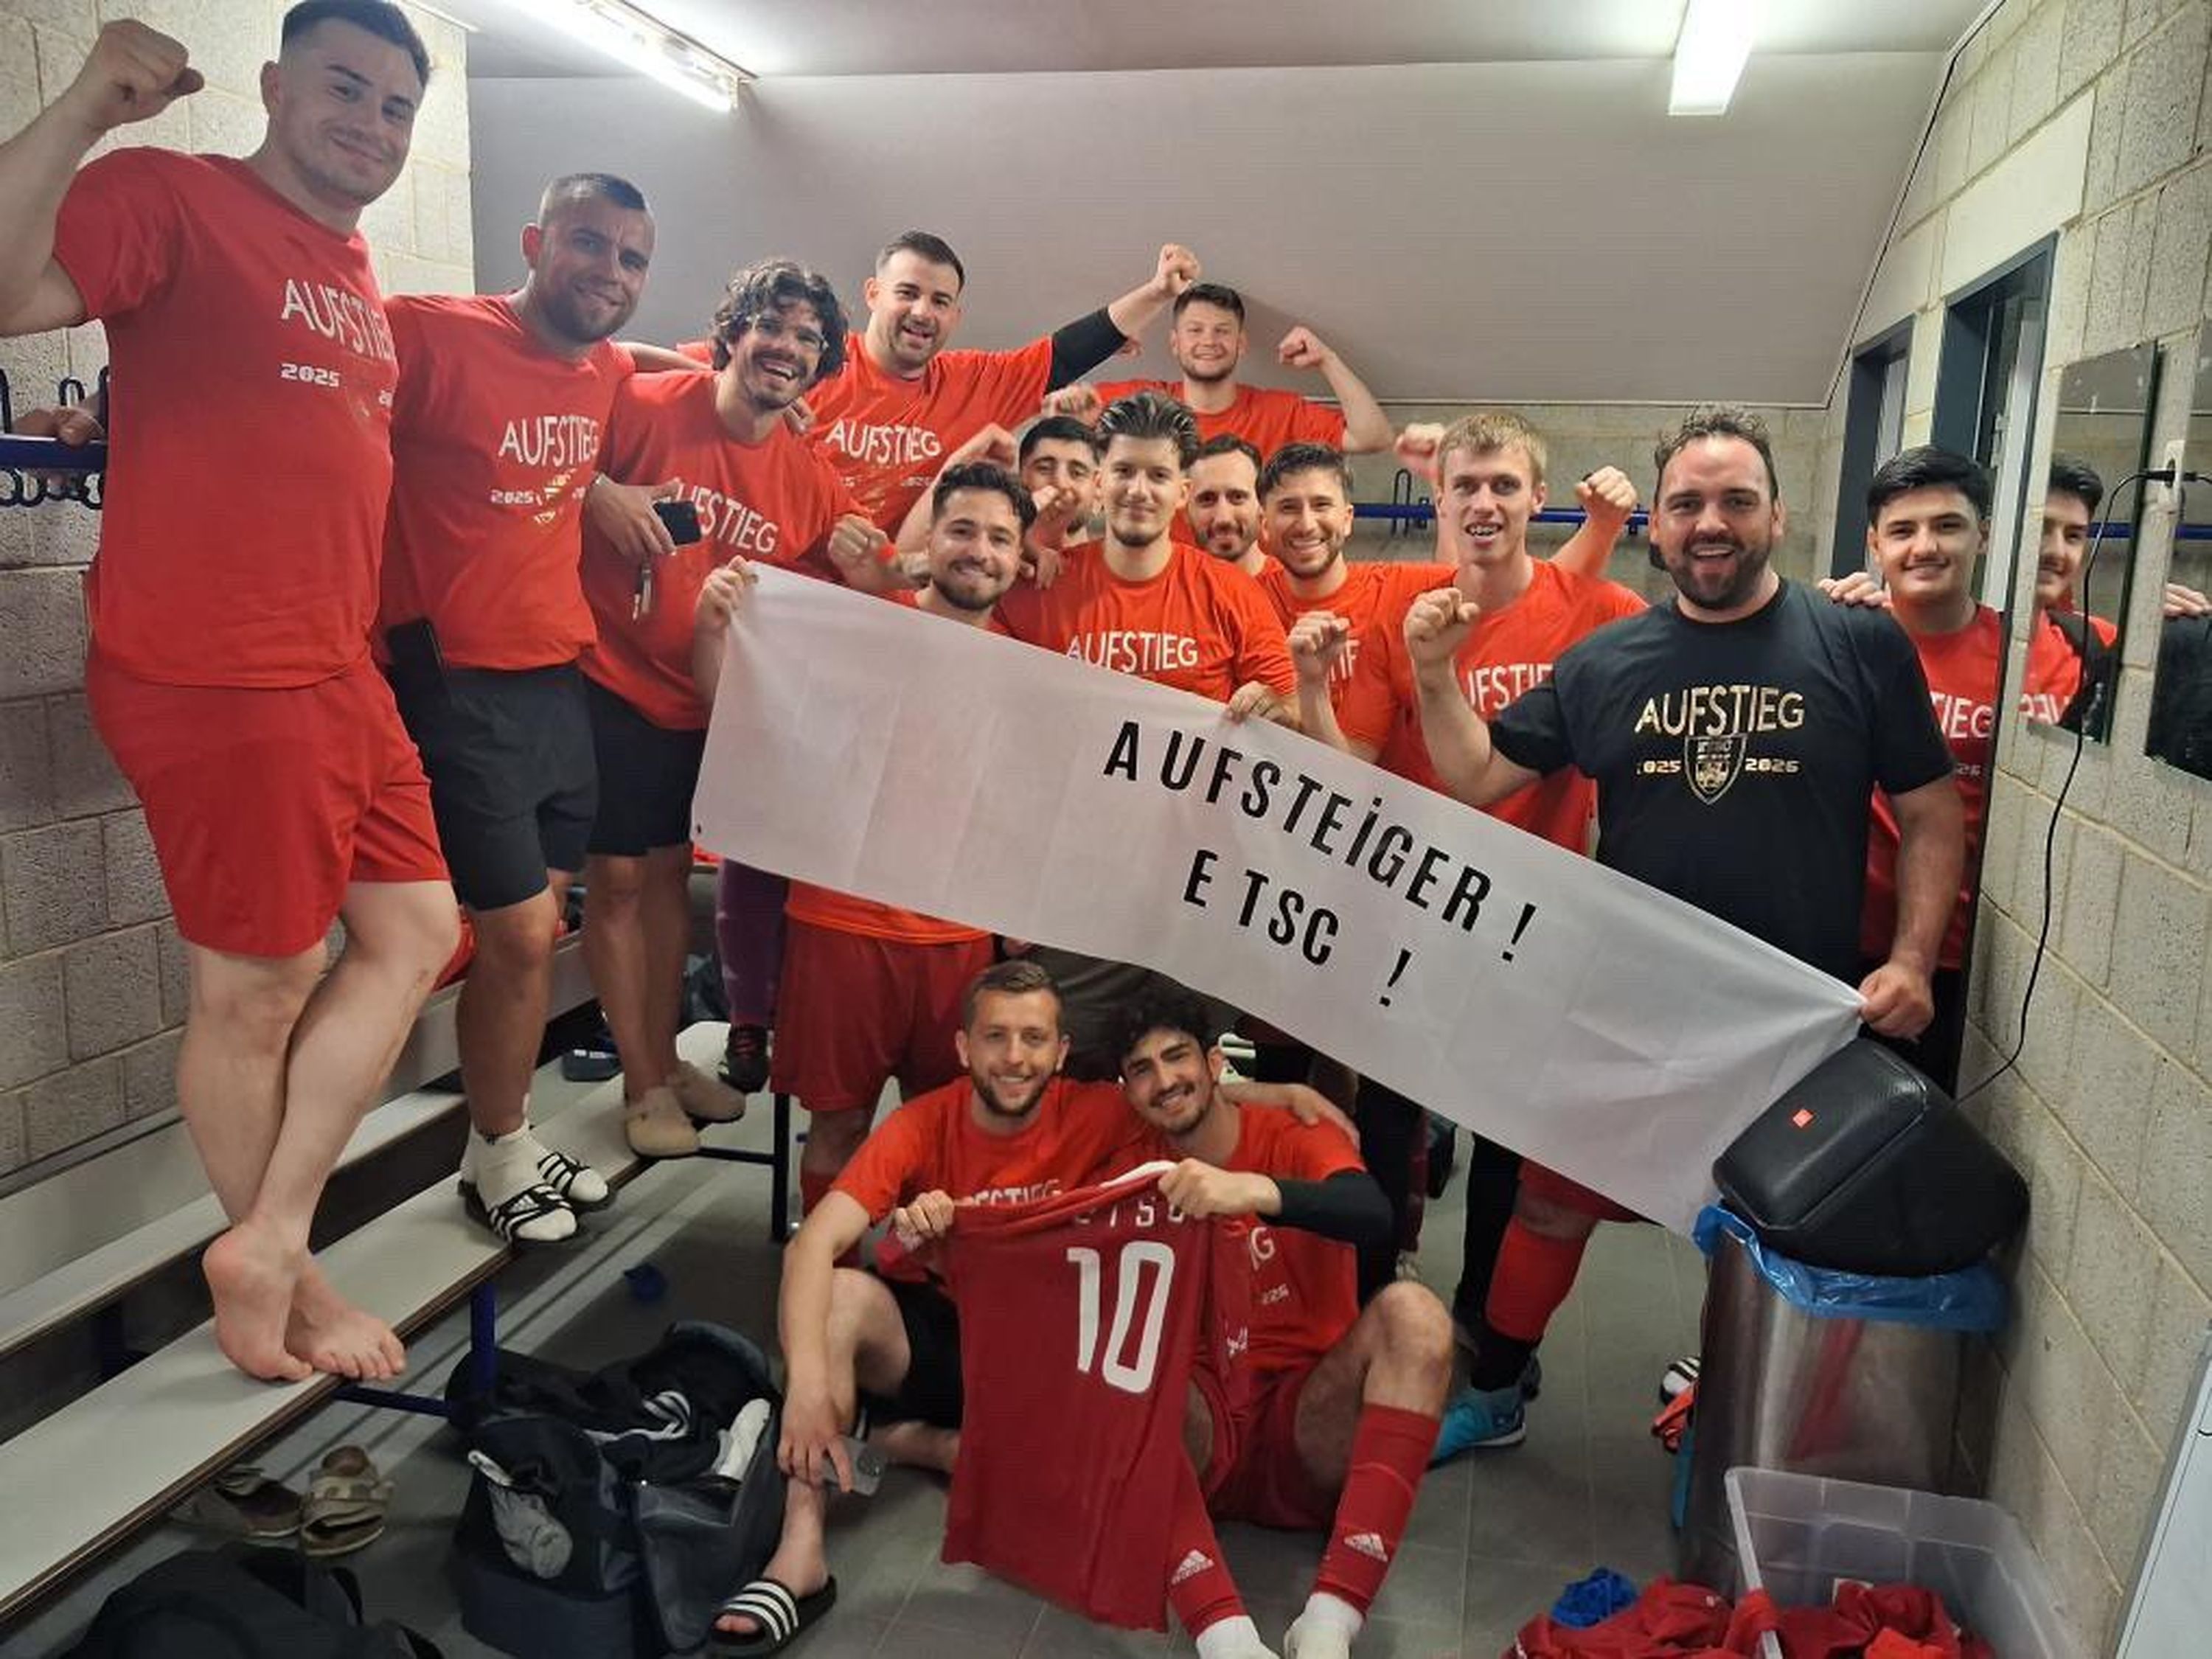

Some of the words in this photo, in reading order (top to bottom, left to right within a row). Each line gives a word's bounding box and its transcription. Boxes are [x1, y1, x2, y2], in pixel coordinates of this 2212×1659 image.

[280, 363, 341, 388] 2025
[498, 414, 599, 467] AUFSTIEG
[824, 417, 942, 465] AUFSTIEG
[491, 488, 535, 504] 2025
[1066, 630, 1198, 673] AUFSTIEG
[1634, 684, 1805, 737] AUFSTIEG
[1501, 902, 1537, 962] !
[1379, 948, 1413, 1008] !
[1066, 1240, 1176, 1394] 10
